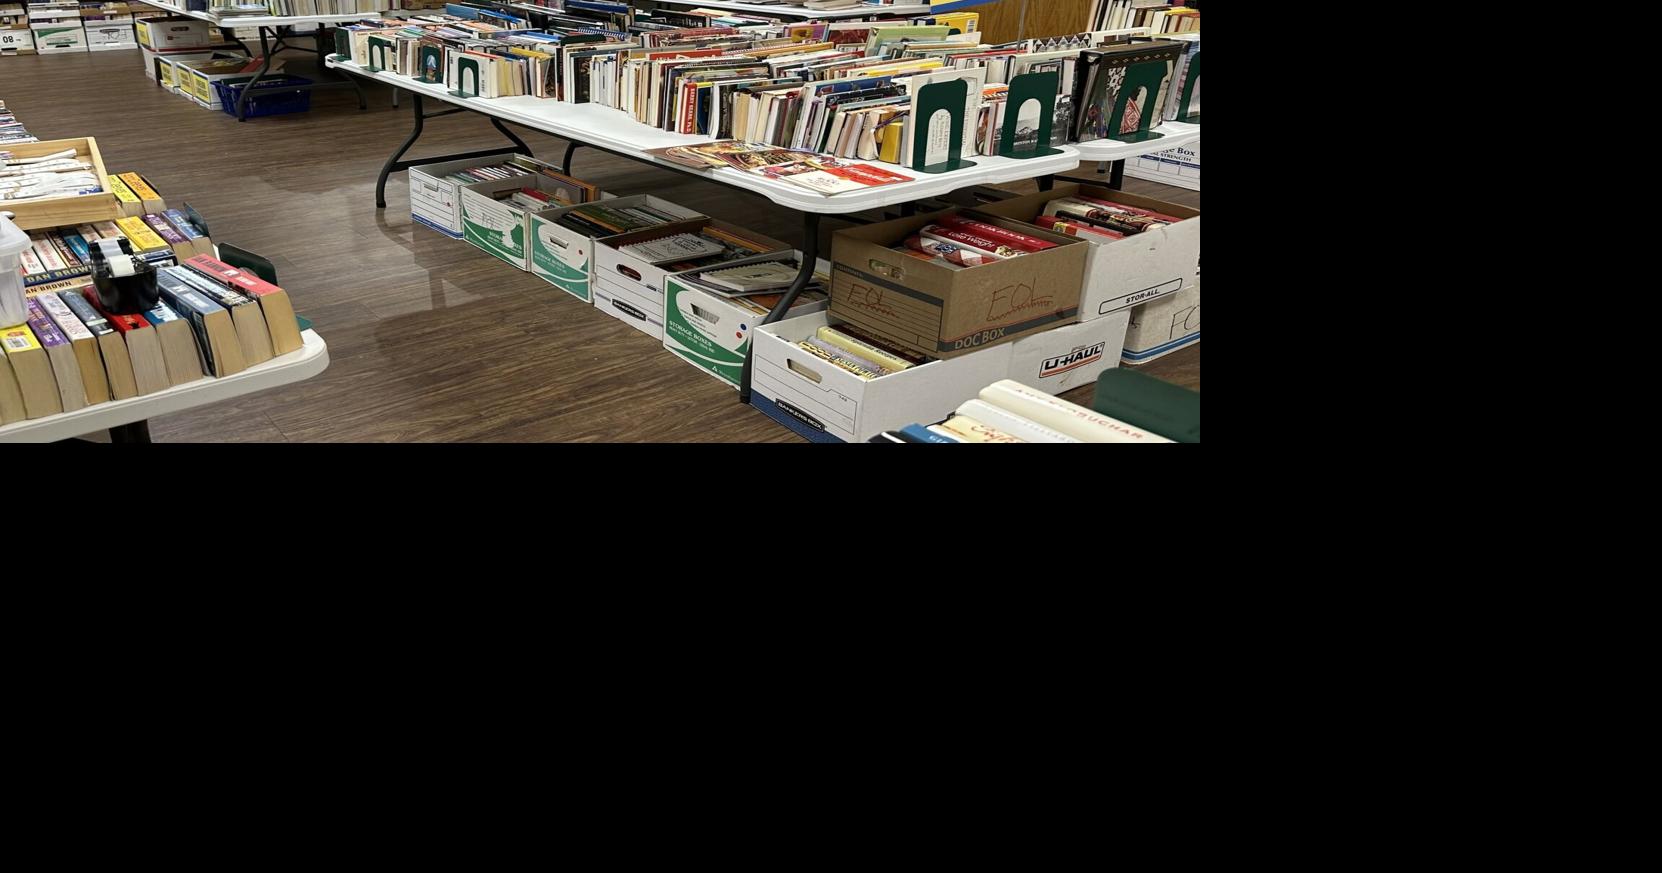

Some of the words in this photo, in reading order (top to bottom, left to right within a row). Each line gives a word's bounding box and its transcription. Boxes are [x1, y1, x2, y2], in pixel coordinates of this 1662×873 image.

[1160, 153, 1192, 162] STRENGTH
[1177, 147, 1196, 156] Box
[26, 273, 51, 283] DAN
[40, 281, 72, 291] BROWN
[987, 278, 1054, 321] FOL
[954, 334, 980, 350] DOC
[981, 327, 1006, 343] BOX
[1044, 346, 1102, 370] U-HAUL
[778, 401, 808, 422] BANKERS
[807, 418, 822, 430] BOX
